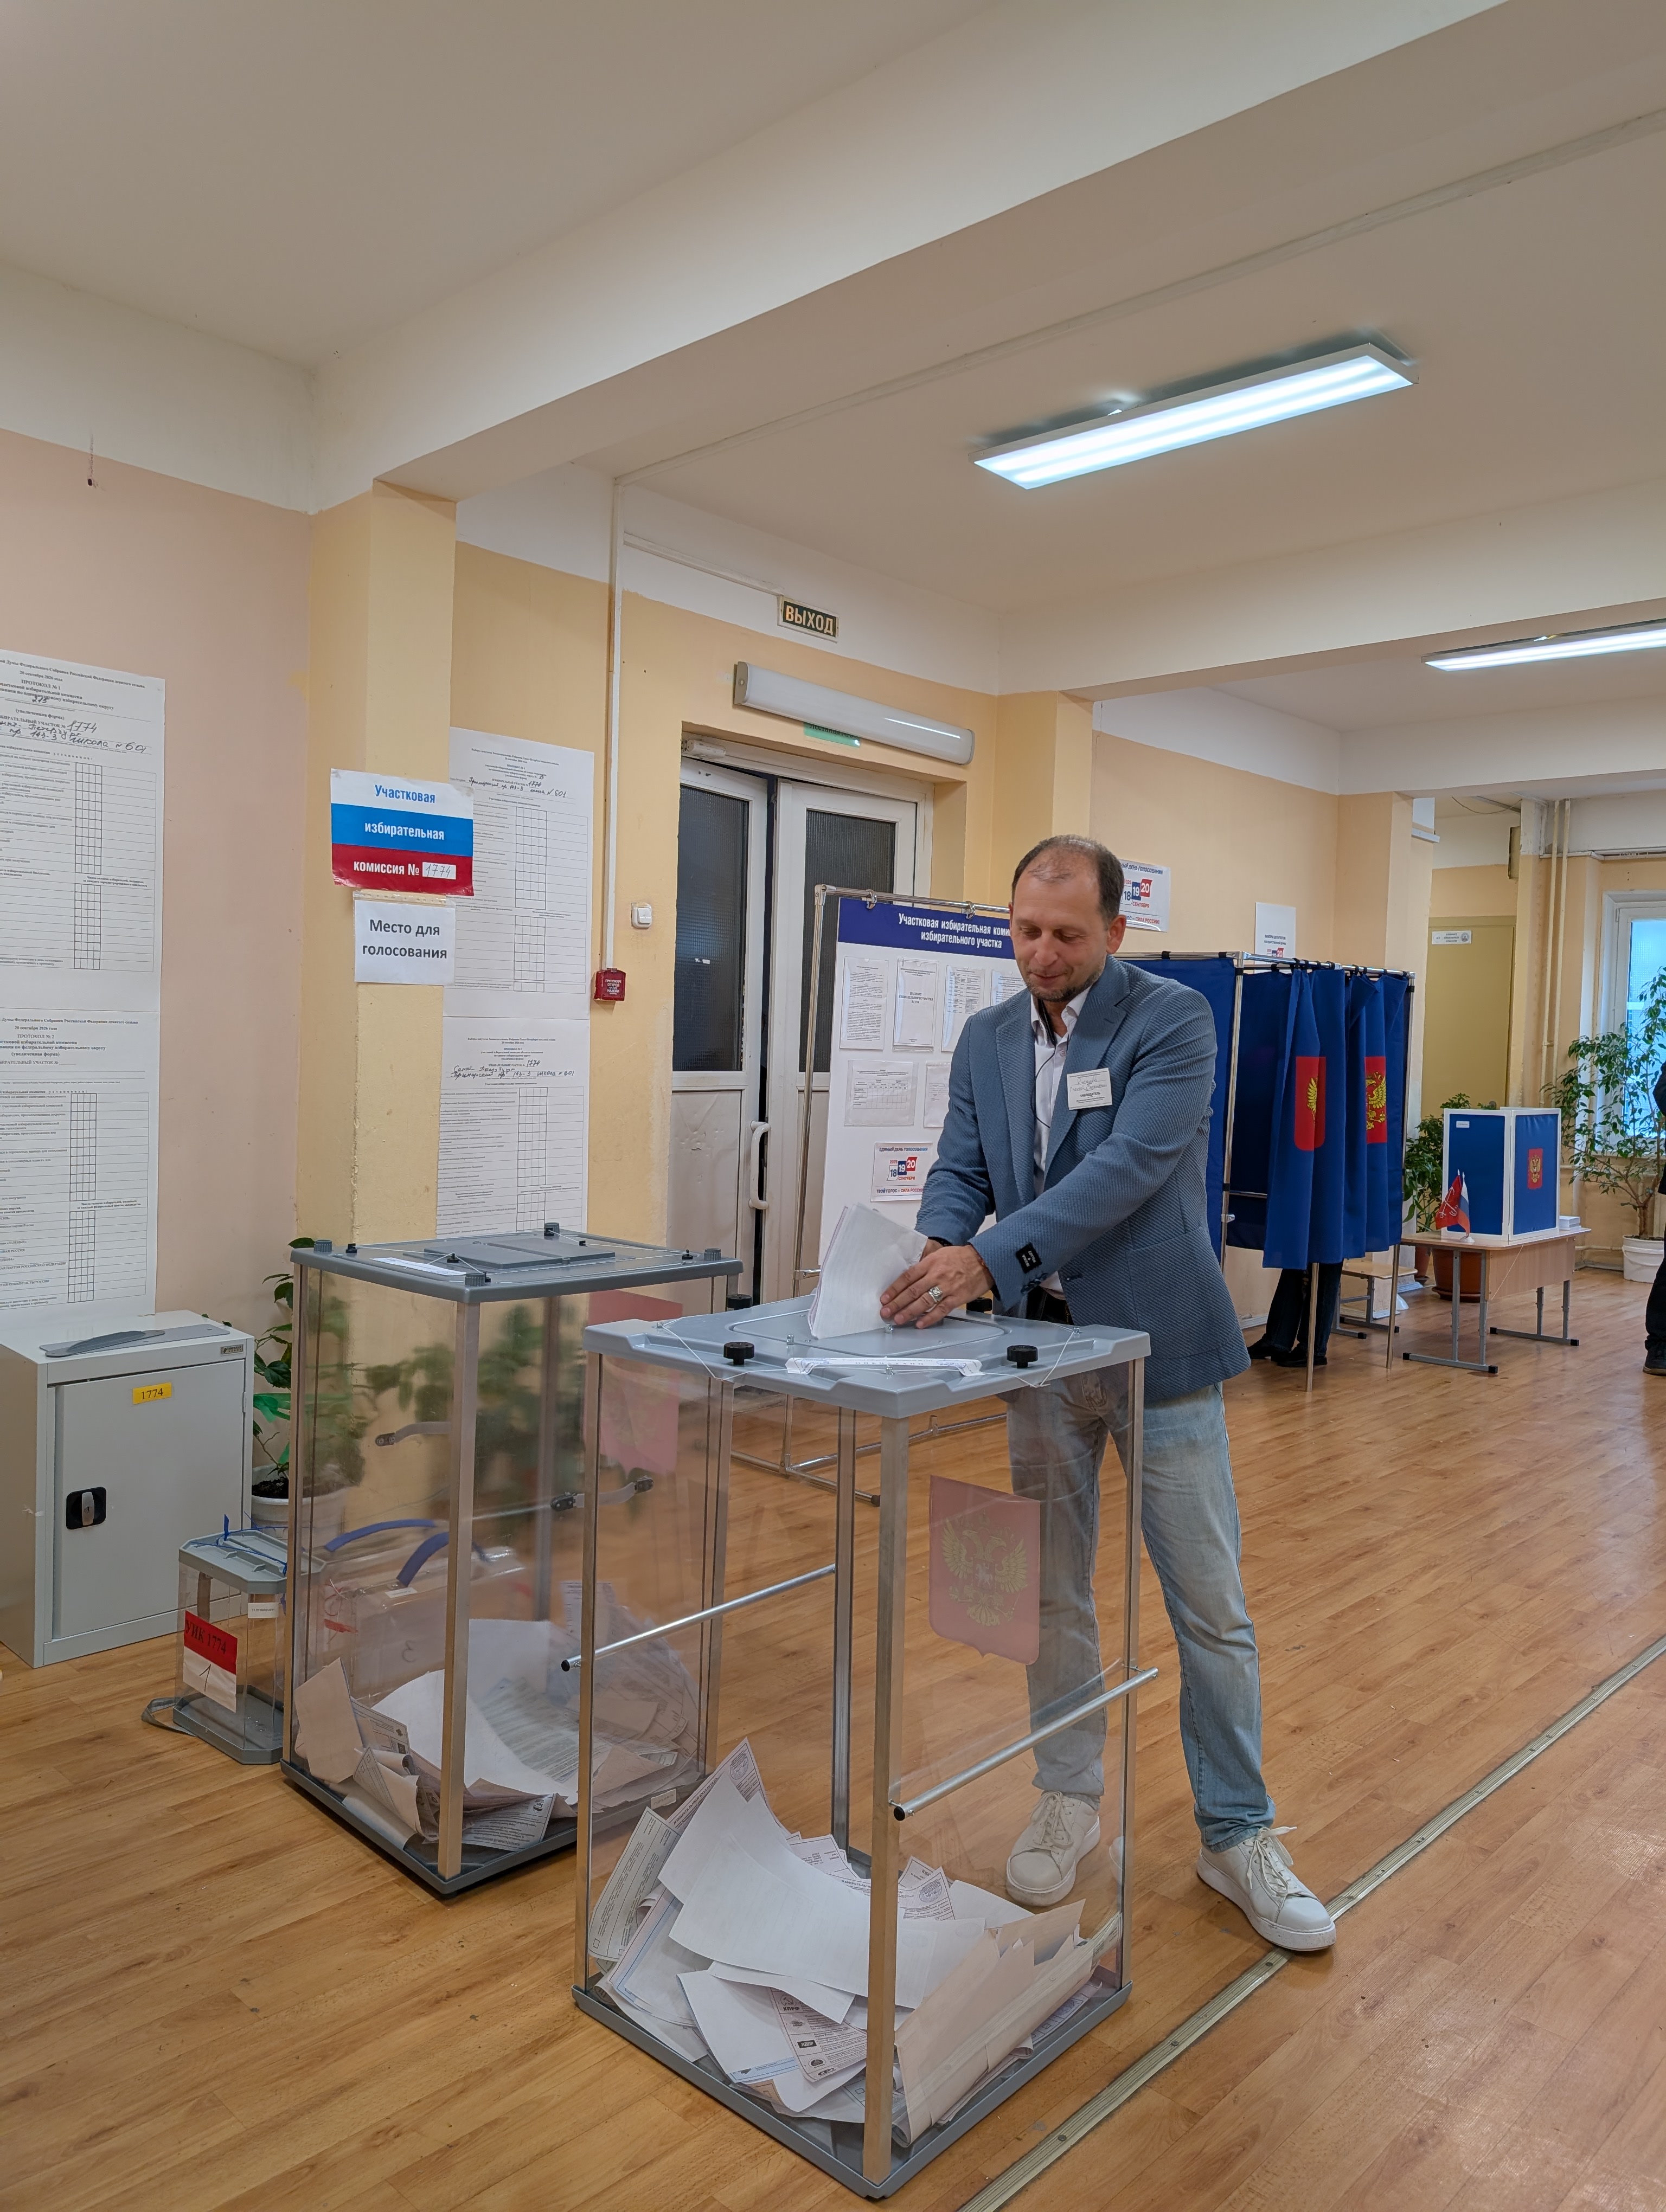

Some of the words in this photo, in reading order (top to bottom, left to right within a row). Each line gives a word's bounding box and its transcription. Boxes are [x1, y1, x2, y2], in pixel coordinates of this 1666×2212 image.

[786, 605, 834, 635] ВЫХОД
[21, 679, 51, 689] ПРОТОКОЛ
[67, 720, 97, 733] 1774
[374, 784, 436, 803] Участковая
[364, 821, 445, 840] избирательная
[354, 861, 405, 875] комиссия
[408, 864, 420, 876] №
[425, 863, 451, 878] 1774
[1138, 866, 1163, 874] ГОЛОСОВАНИЯ
[1124, 890, 1131, 901] 18
[1132, 886, 1139, 897] 19
[1140, 883, 1150, 893] 20
[370, 919, 412, 934] Место
[415, 925, 440, 937] для
[899, 913, 939, 928] Участковая
[941, 919, 991, 935] избирательная
[921, 930, 975, 946] избирательного
[977, 937, 1002, 949] участка
[362, 944, 447, 959] голосования
[890, 1169, 897, 1177] 18
[899, 1164, 906, 1173] 19
[907, 1160, 915, 1168] 20
[142, 1387, 163, 1400] 1774
[185, 1619, 205, 1643] УИК
[208, 1633, 227, 1655] 1774
[199, 1664, 211, 1692] 1
